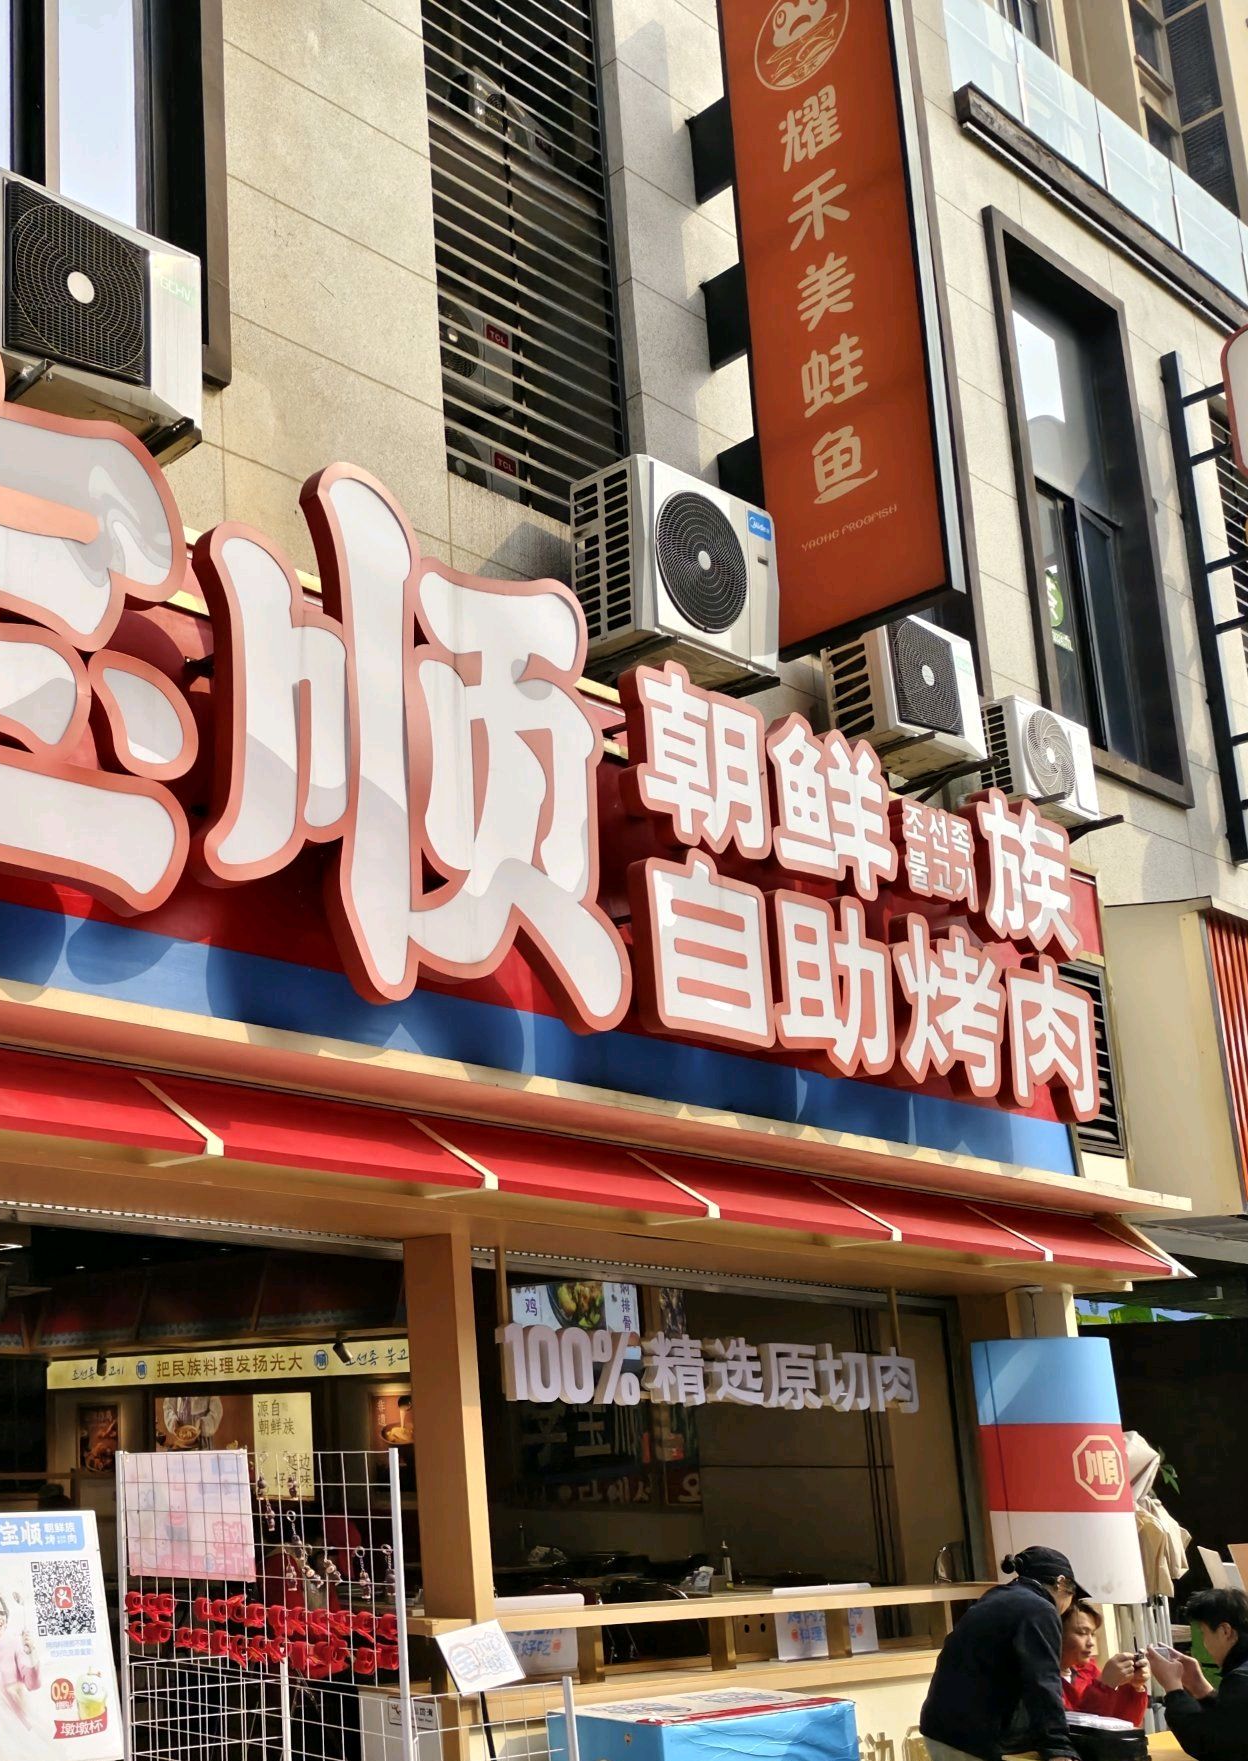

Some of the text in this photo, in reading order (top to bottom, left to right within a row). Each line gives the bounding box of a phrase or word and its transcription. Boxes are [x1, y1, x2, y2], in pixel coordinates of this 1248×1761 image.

[778, 84, 878, 505] 耀禾美蛙鱼
[489, 329, 506, 346] TCL
[496, 457, 513, 473] TCL
[905, 804, 971, 862] 조선족
[909, 847, 975, 907] 불고기
[649, 856, 1098, 1118] 自助烤肉
[156, 1352, 303, 1378] 把民族料理发扬光大
[257, 1400, 280, 1418] 源自
[257, 1418, 295, 1436] 朝鲜族
[287, 1453, 312, 1472] 延边
